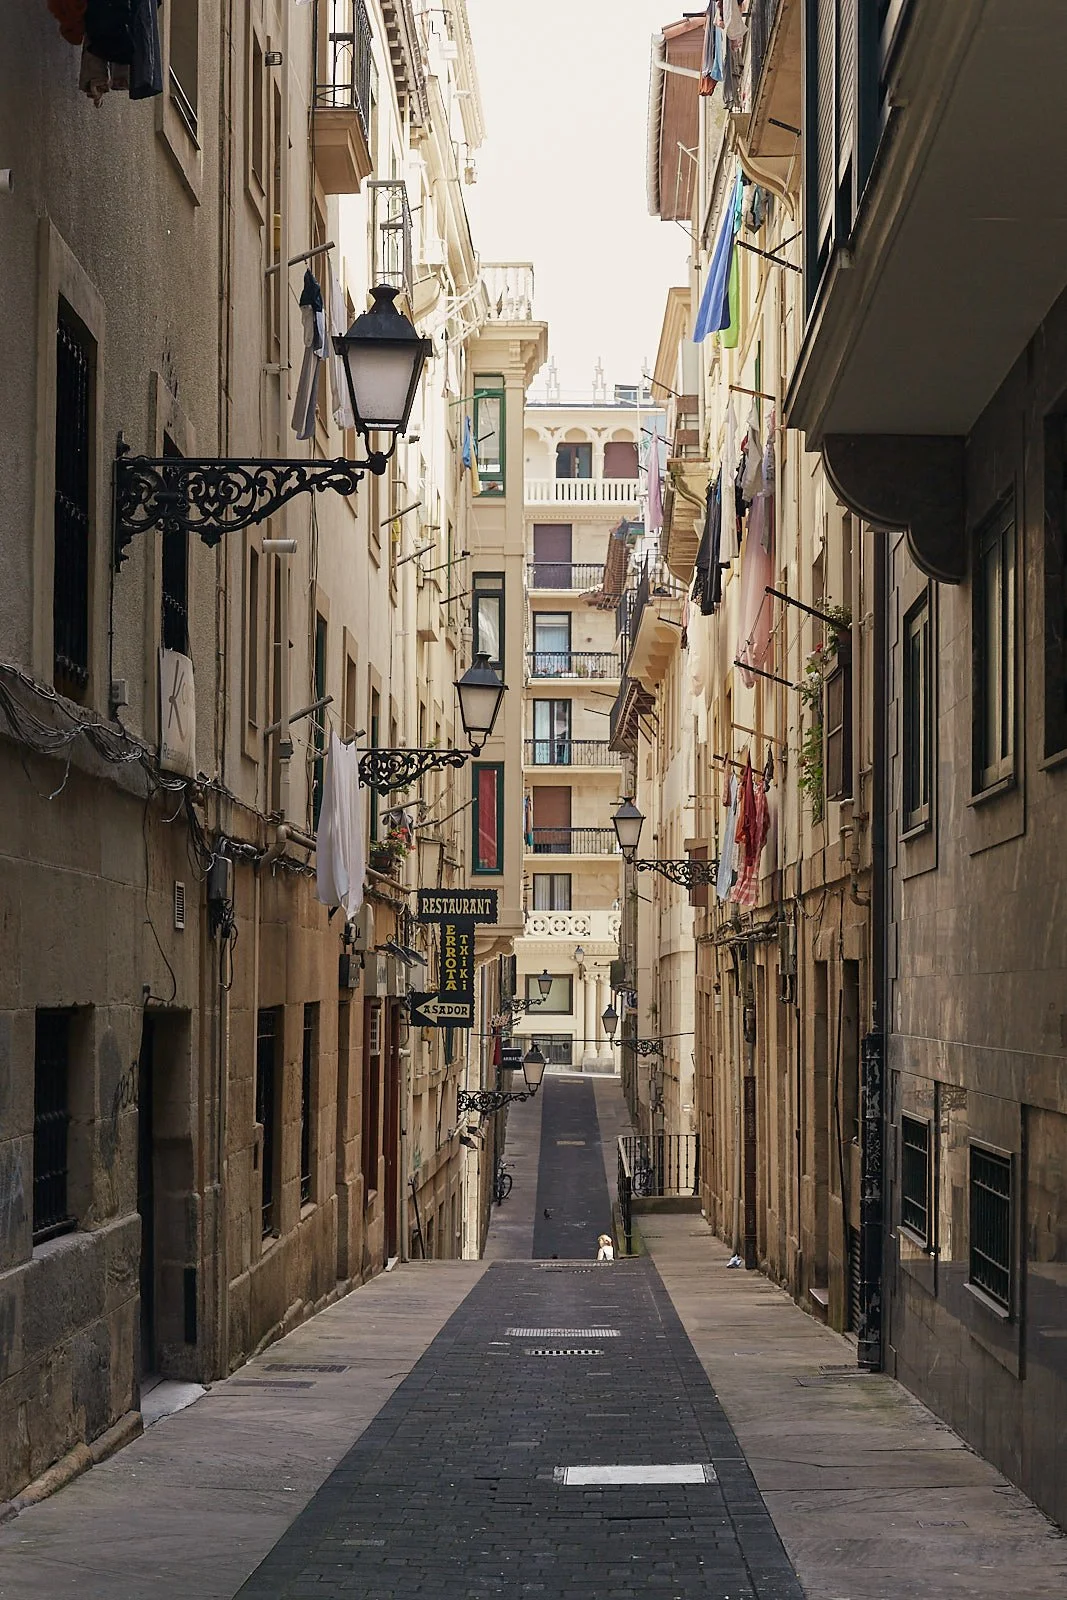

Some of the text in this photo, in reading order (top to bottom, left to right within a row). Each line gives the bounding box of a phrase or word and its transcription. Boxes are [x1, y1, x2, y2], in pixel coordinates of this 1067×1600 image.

[422, 897, 492, 915] RESTAURANT
[445, 925, 457, 991] ERROTA
[423, 1004, 468, 1016] ASADOR
